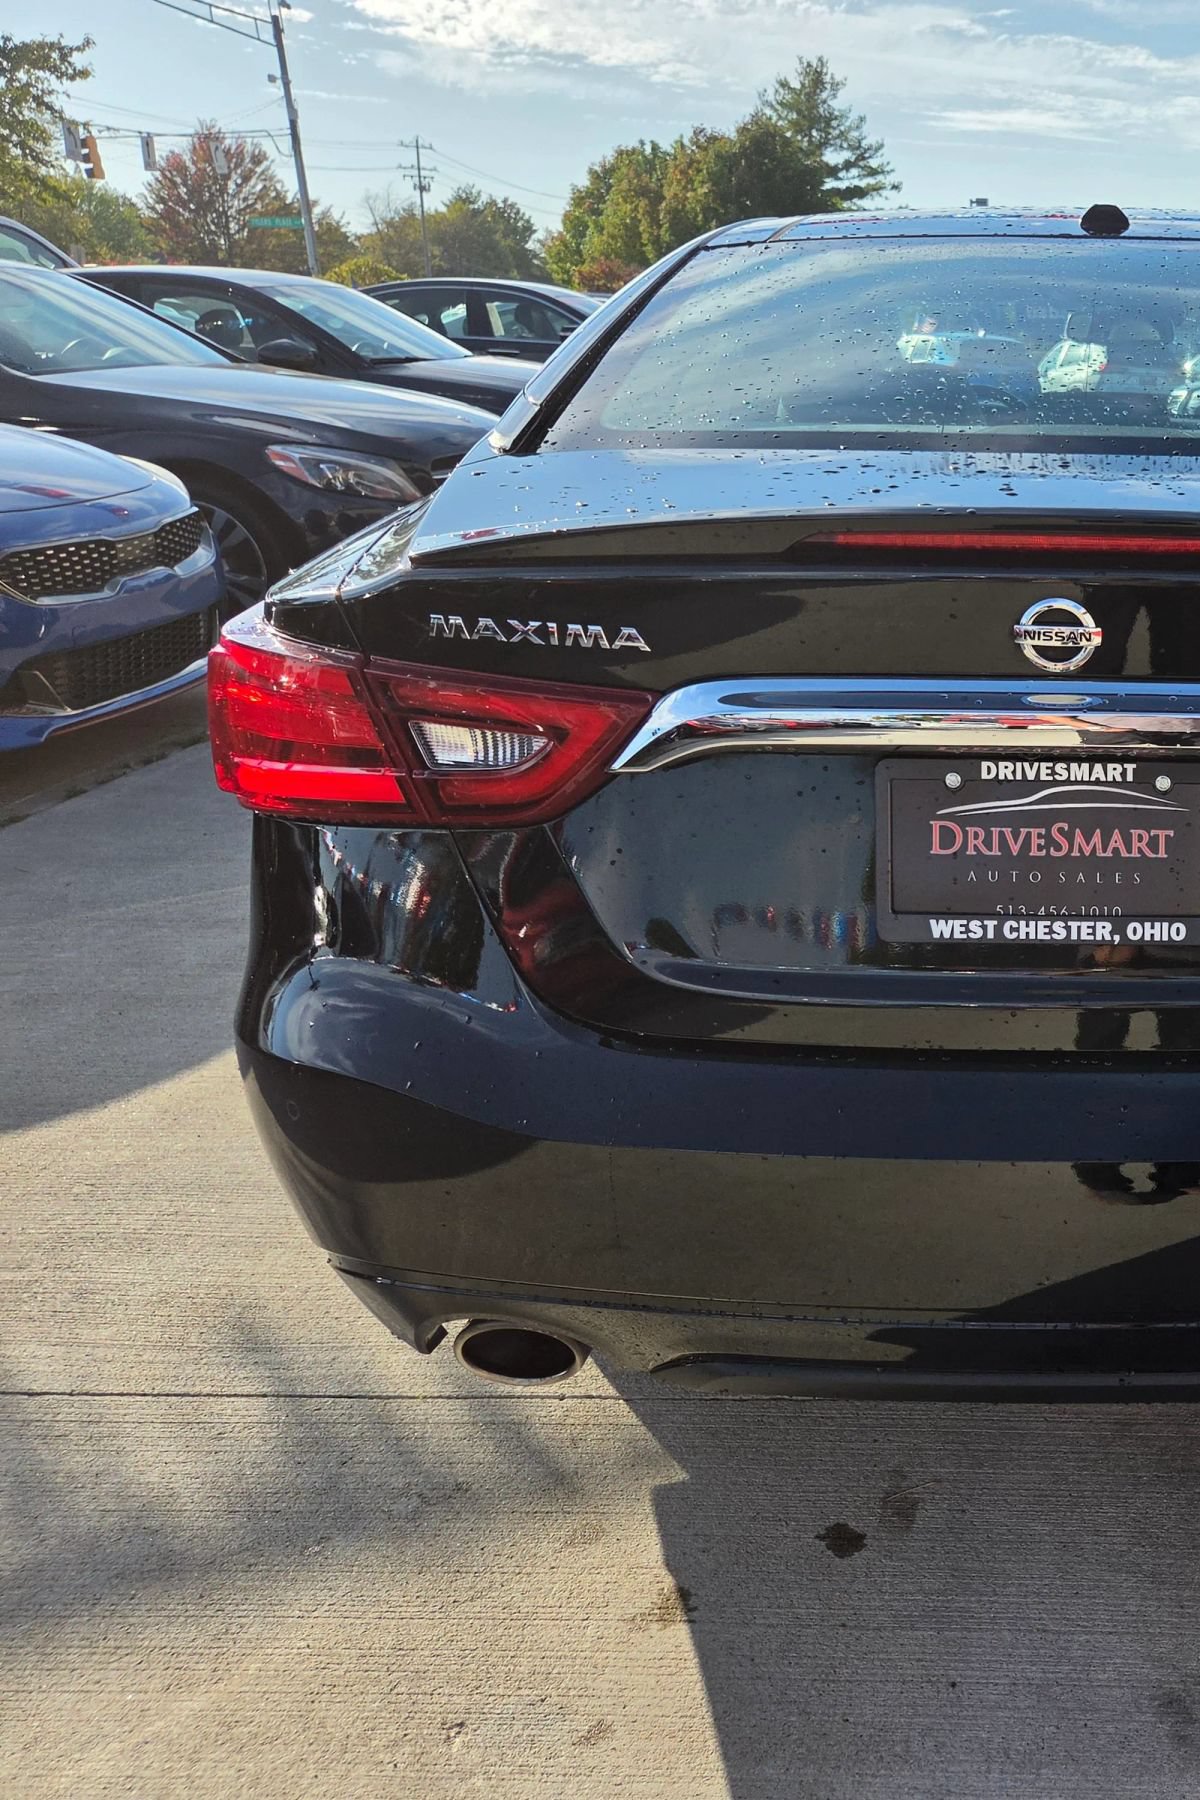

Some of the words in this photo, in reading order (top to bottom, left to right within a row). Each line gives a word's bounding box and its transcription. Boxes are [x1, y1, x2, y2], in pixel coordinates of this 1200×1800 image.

[429, 614, 651, 651] MAXIMA
[1023, 630, 1092, 643] NISSAN
[980, 761, 1137, 783] DRIVESMART
[967, 870, 1042, 884] AUTO
[1058, 871, 1141, 885] SALES
[929, 918, 998, 940] WEST
[1003, 920, 1120, 945] CHESTER,
[1126, 921, 1187, 942] OHIO
